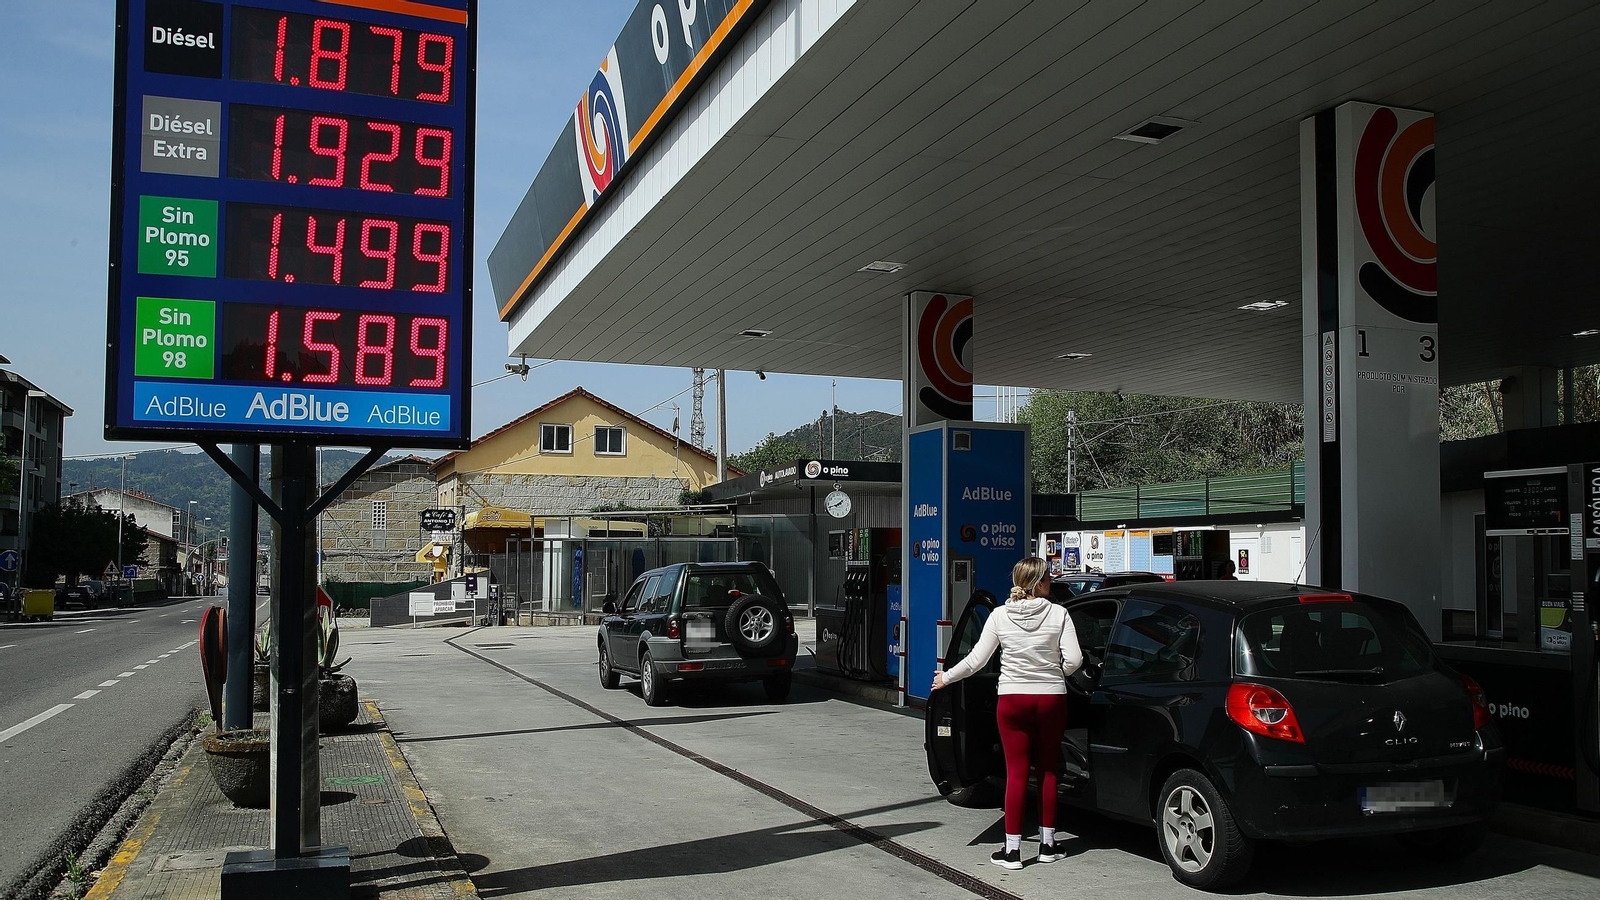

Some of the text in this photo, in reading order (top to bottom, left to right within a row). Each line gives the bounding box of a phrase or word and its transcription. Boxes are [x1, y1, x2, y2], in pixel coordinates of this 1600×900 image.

[152, 26, 215, 50] Diésel
[652, 0, 706, 64] o p
[274, 16, 454, 102] 1.879
[150, 114, 212, 136] Diésel
[153, 140, 208, 160] Extra
[271, 114, 452, 197] 1.929
[162, 206, 194, 225] Sin
[146, 227, 210, 247] Plomo
[165, 250, 189, 267] 95
[268, 212, 450, 292] 1.499
[159, 308, 191, 326] Sin
[142, 328, 208, 348] Plomo
[1358, 330, 1370, 357] 1
[266, 310, 448, 387] 1.589
[1420, 336, 1436, 362] 3
[162, 351, 187, 368] 98
[1358, 371, 1392, 380] PRODUCTO
[145, 395, 226, 418] AdBlue
[246, 392, 350, 422] AdBlue
[367, 405, 440, 425] AdBlue
[830, 466, 849, 475] pino
[962, 486, 1012, 500] AdBlue
[914, 503, 938, 517] AdBlue
[981, 522, 1016, 535] o pino
[922, 538, 940, 551] o pino
[980, 534, 1015, 546] o viso
[922, 551, 939, 562] o viso
[1092, 551, 1103, 561] pino
[1488, 702, 1529, 719] o pino
[1384, 736, 1418, 745] CLIO
